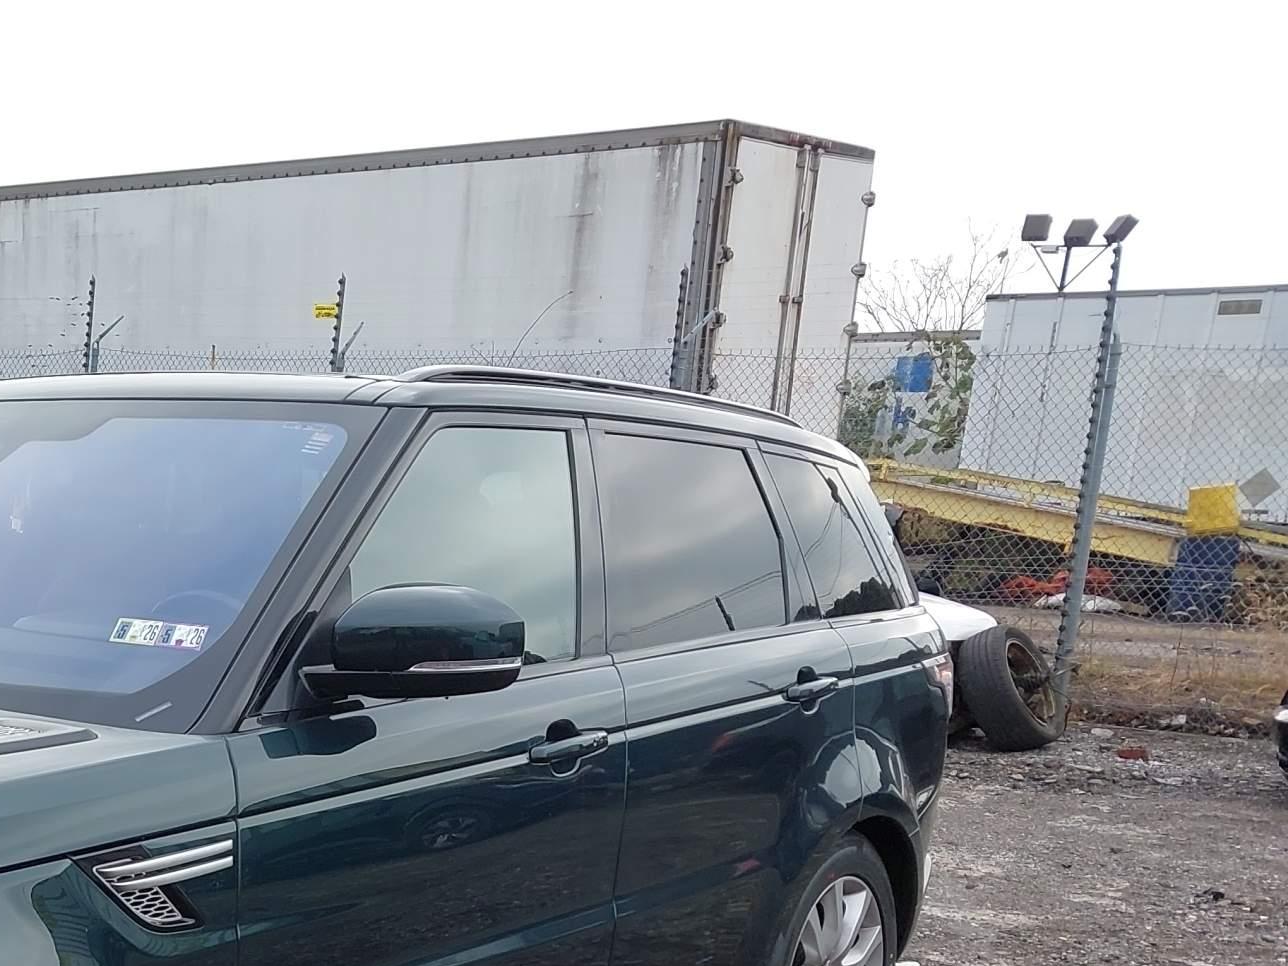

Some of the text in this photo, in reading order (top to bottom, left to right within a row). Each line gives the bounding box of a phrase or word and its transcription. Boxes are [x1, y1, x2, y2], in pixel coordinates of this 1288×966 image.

[117, 623, 159, 641] 5 26
[162, 628, 205, 645] 5 26
